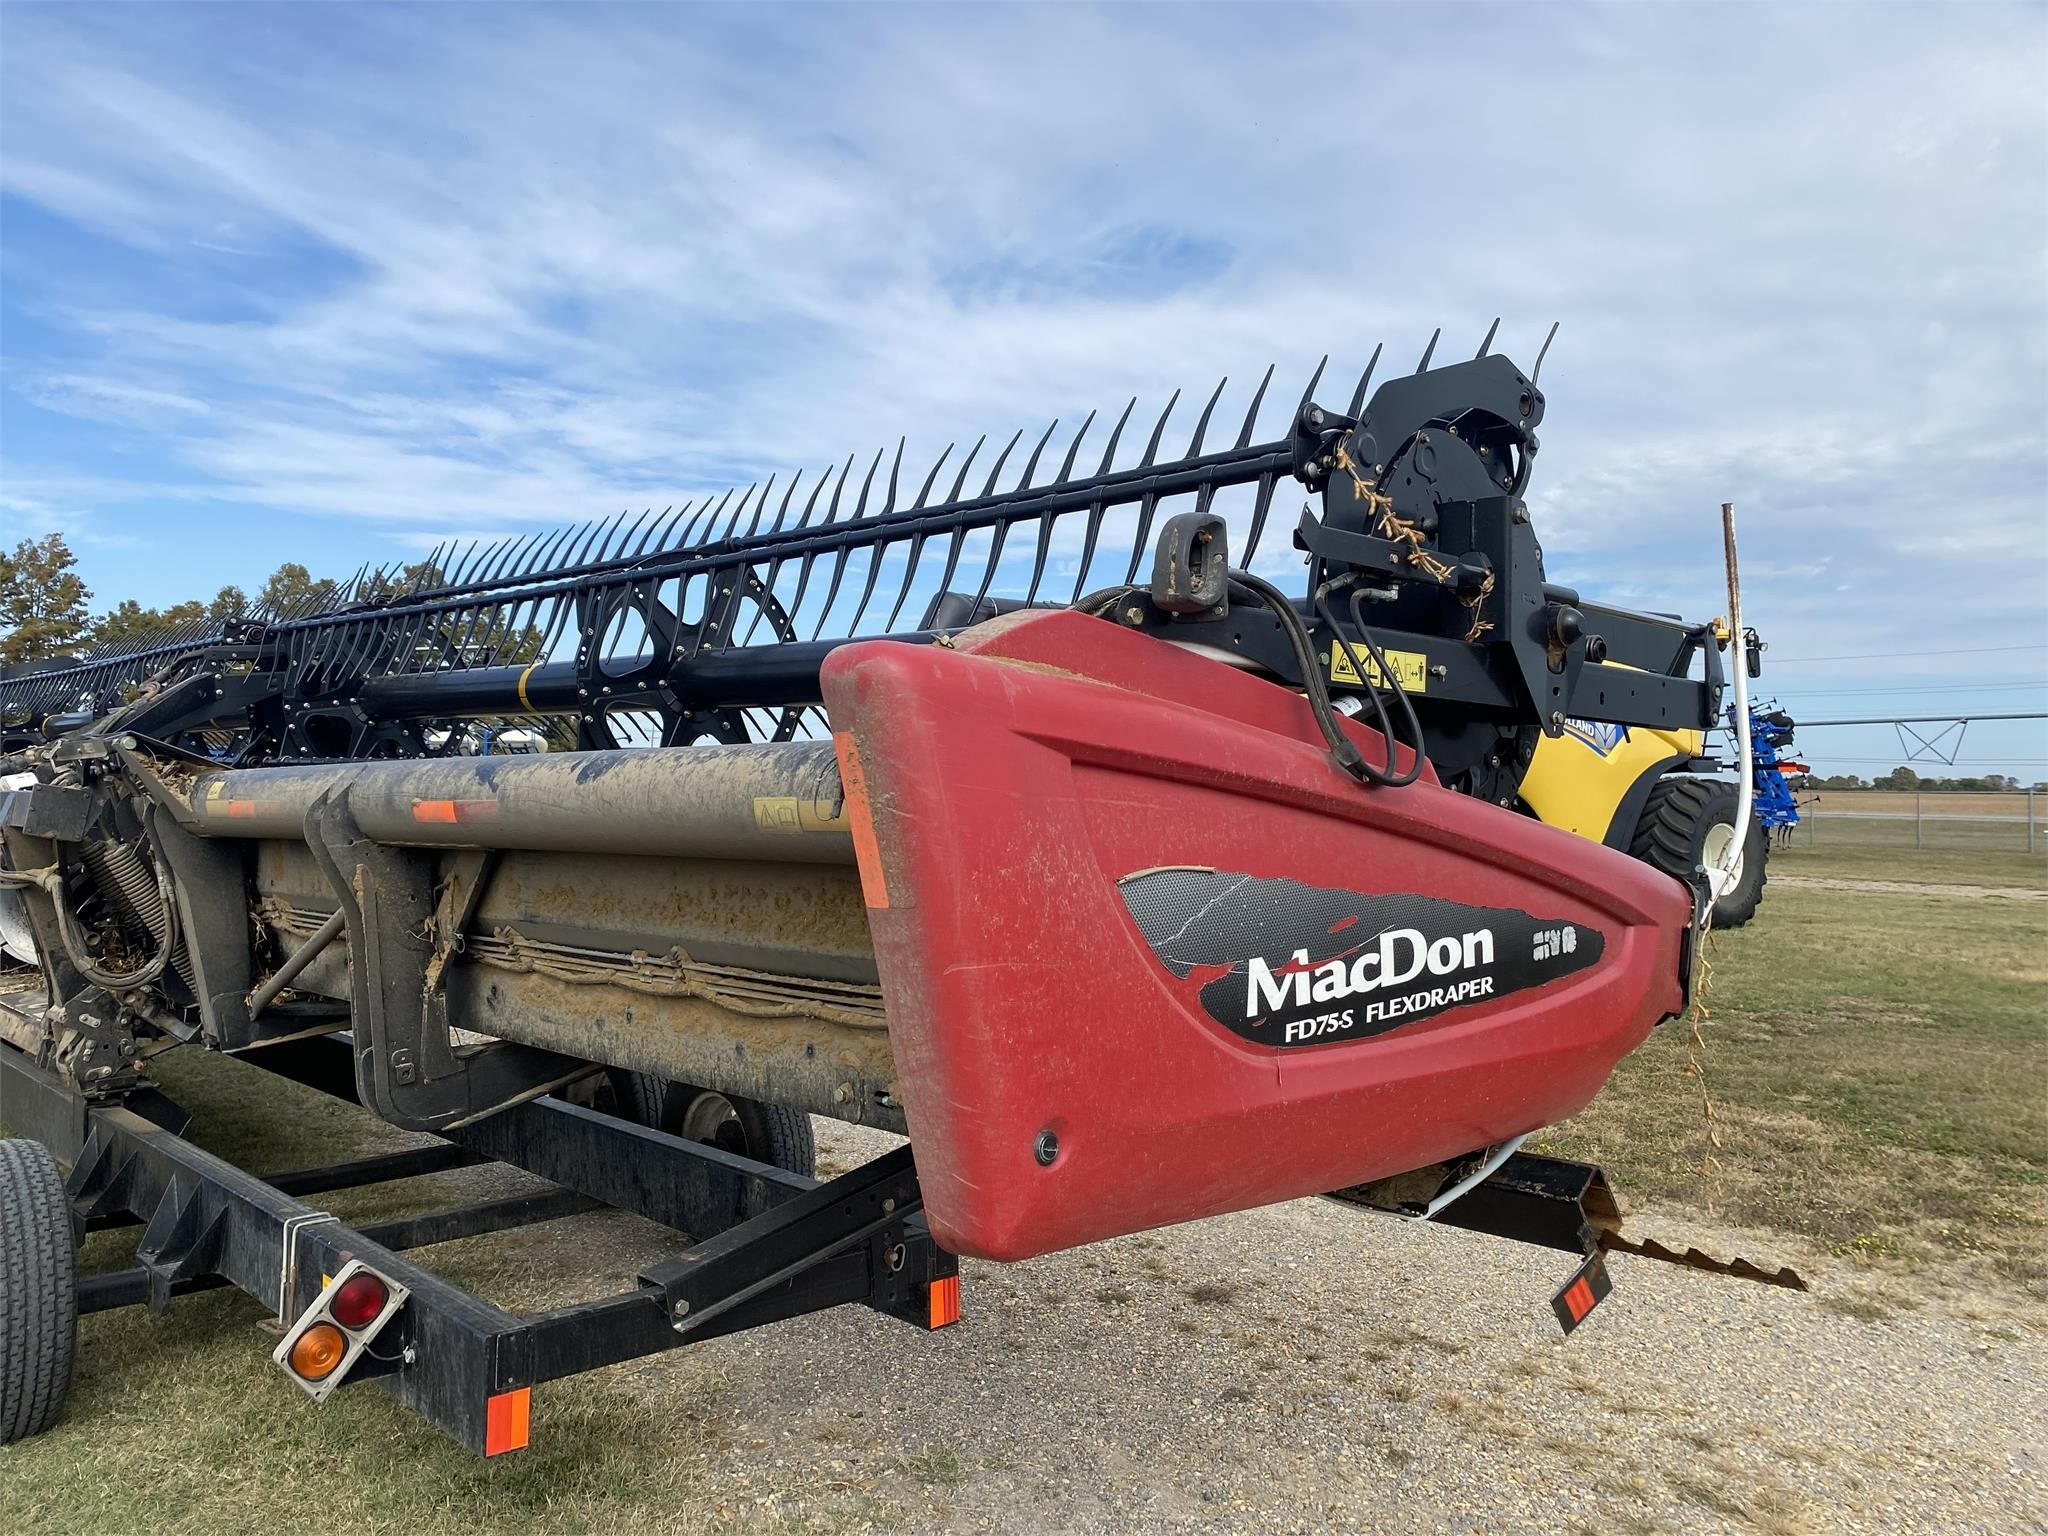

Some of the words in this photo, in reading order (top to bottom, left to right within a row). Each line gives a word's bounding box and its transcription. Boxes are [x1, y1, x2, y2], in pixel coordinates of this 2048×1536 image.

[1247, 928, 1494, 1017] MacDon
[1285, 1009, 1354, 1043] FD75-S
[1366, 976, 1494, 1023] FLEXDRAPER
